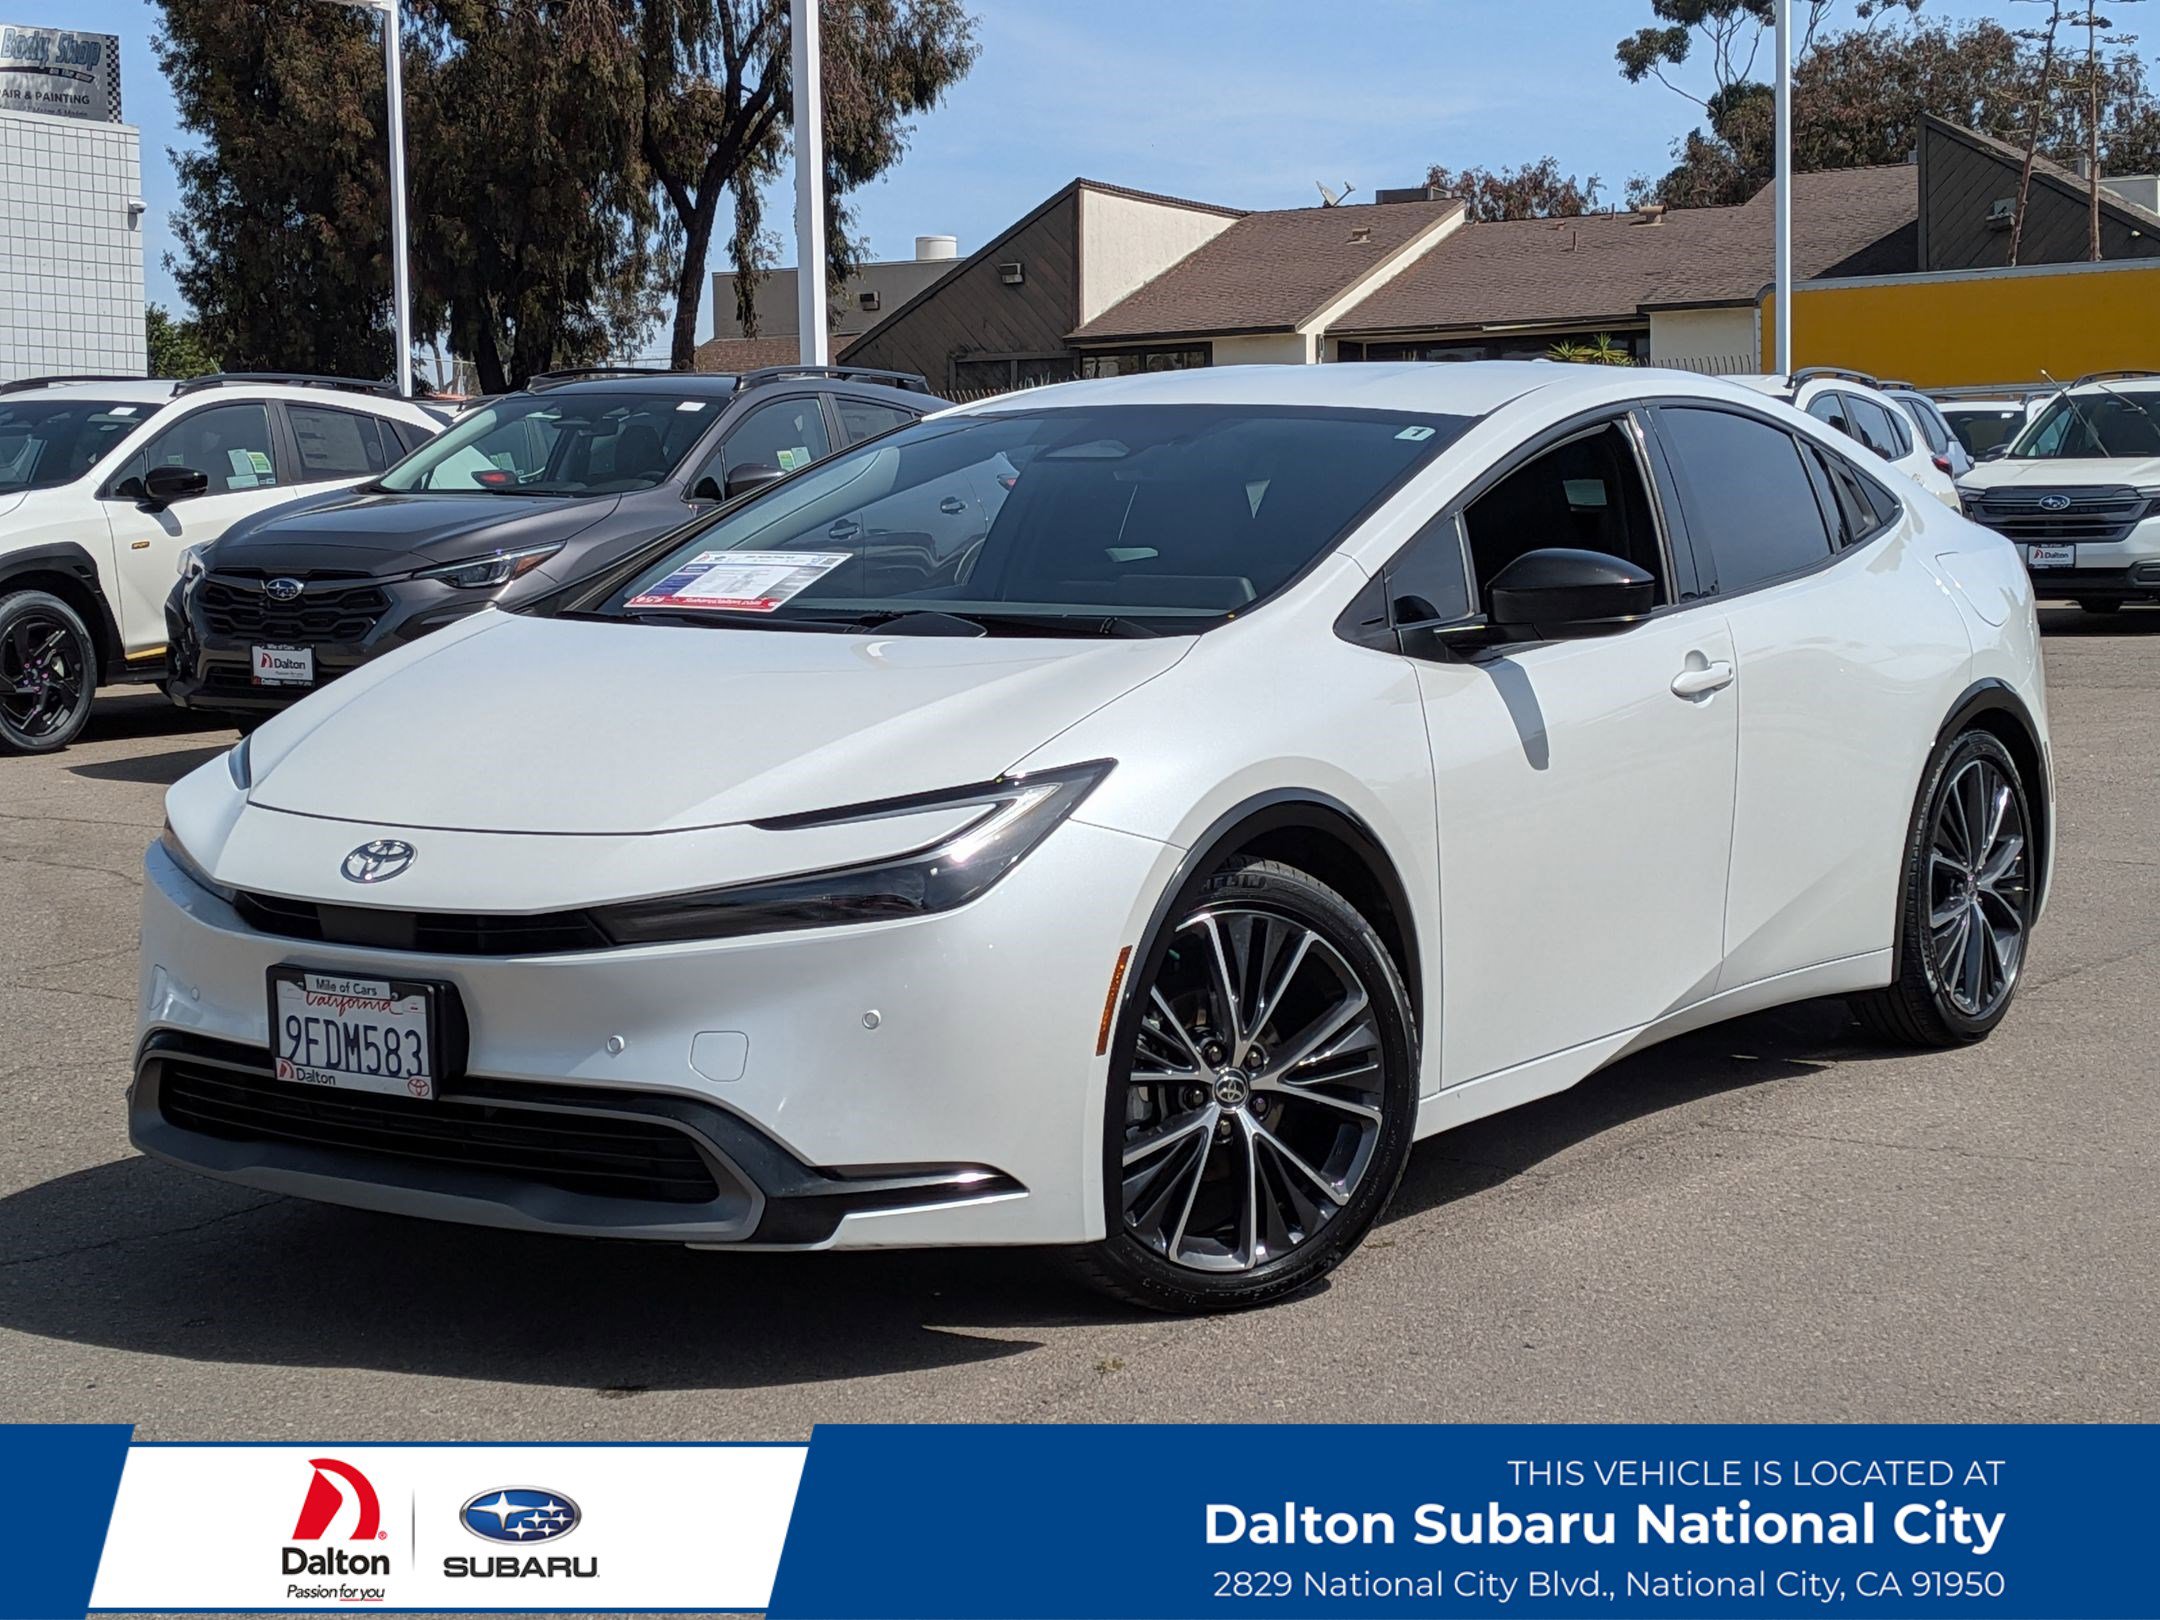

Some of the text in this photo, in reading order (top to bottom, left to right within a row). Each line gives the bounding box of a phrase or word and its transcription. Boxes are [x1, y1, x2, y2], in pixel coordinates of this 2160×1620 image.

[1, 28, 101, 71] Body Shop
[0, 88, 90, 105] AIR & PAINTING
[2045, 551, 2069, 559] Dalton
[274, 658, 306, 670] Dalton
[316, 978, 378, 996] Mile of Cars
[285, 1014, 422, 1077] 9FDM583
[296, 1068, 336, 1086] Dalton
